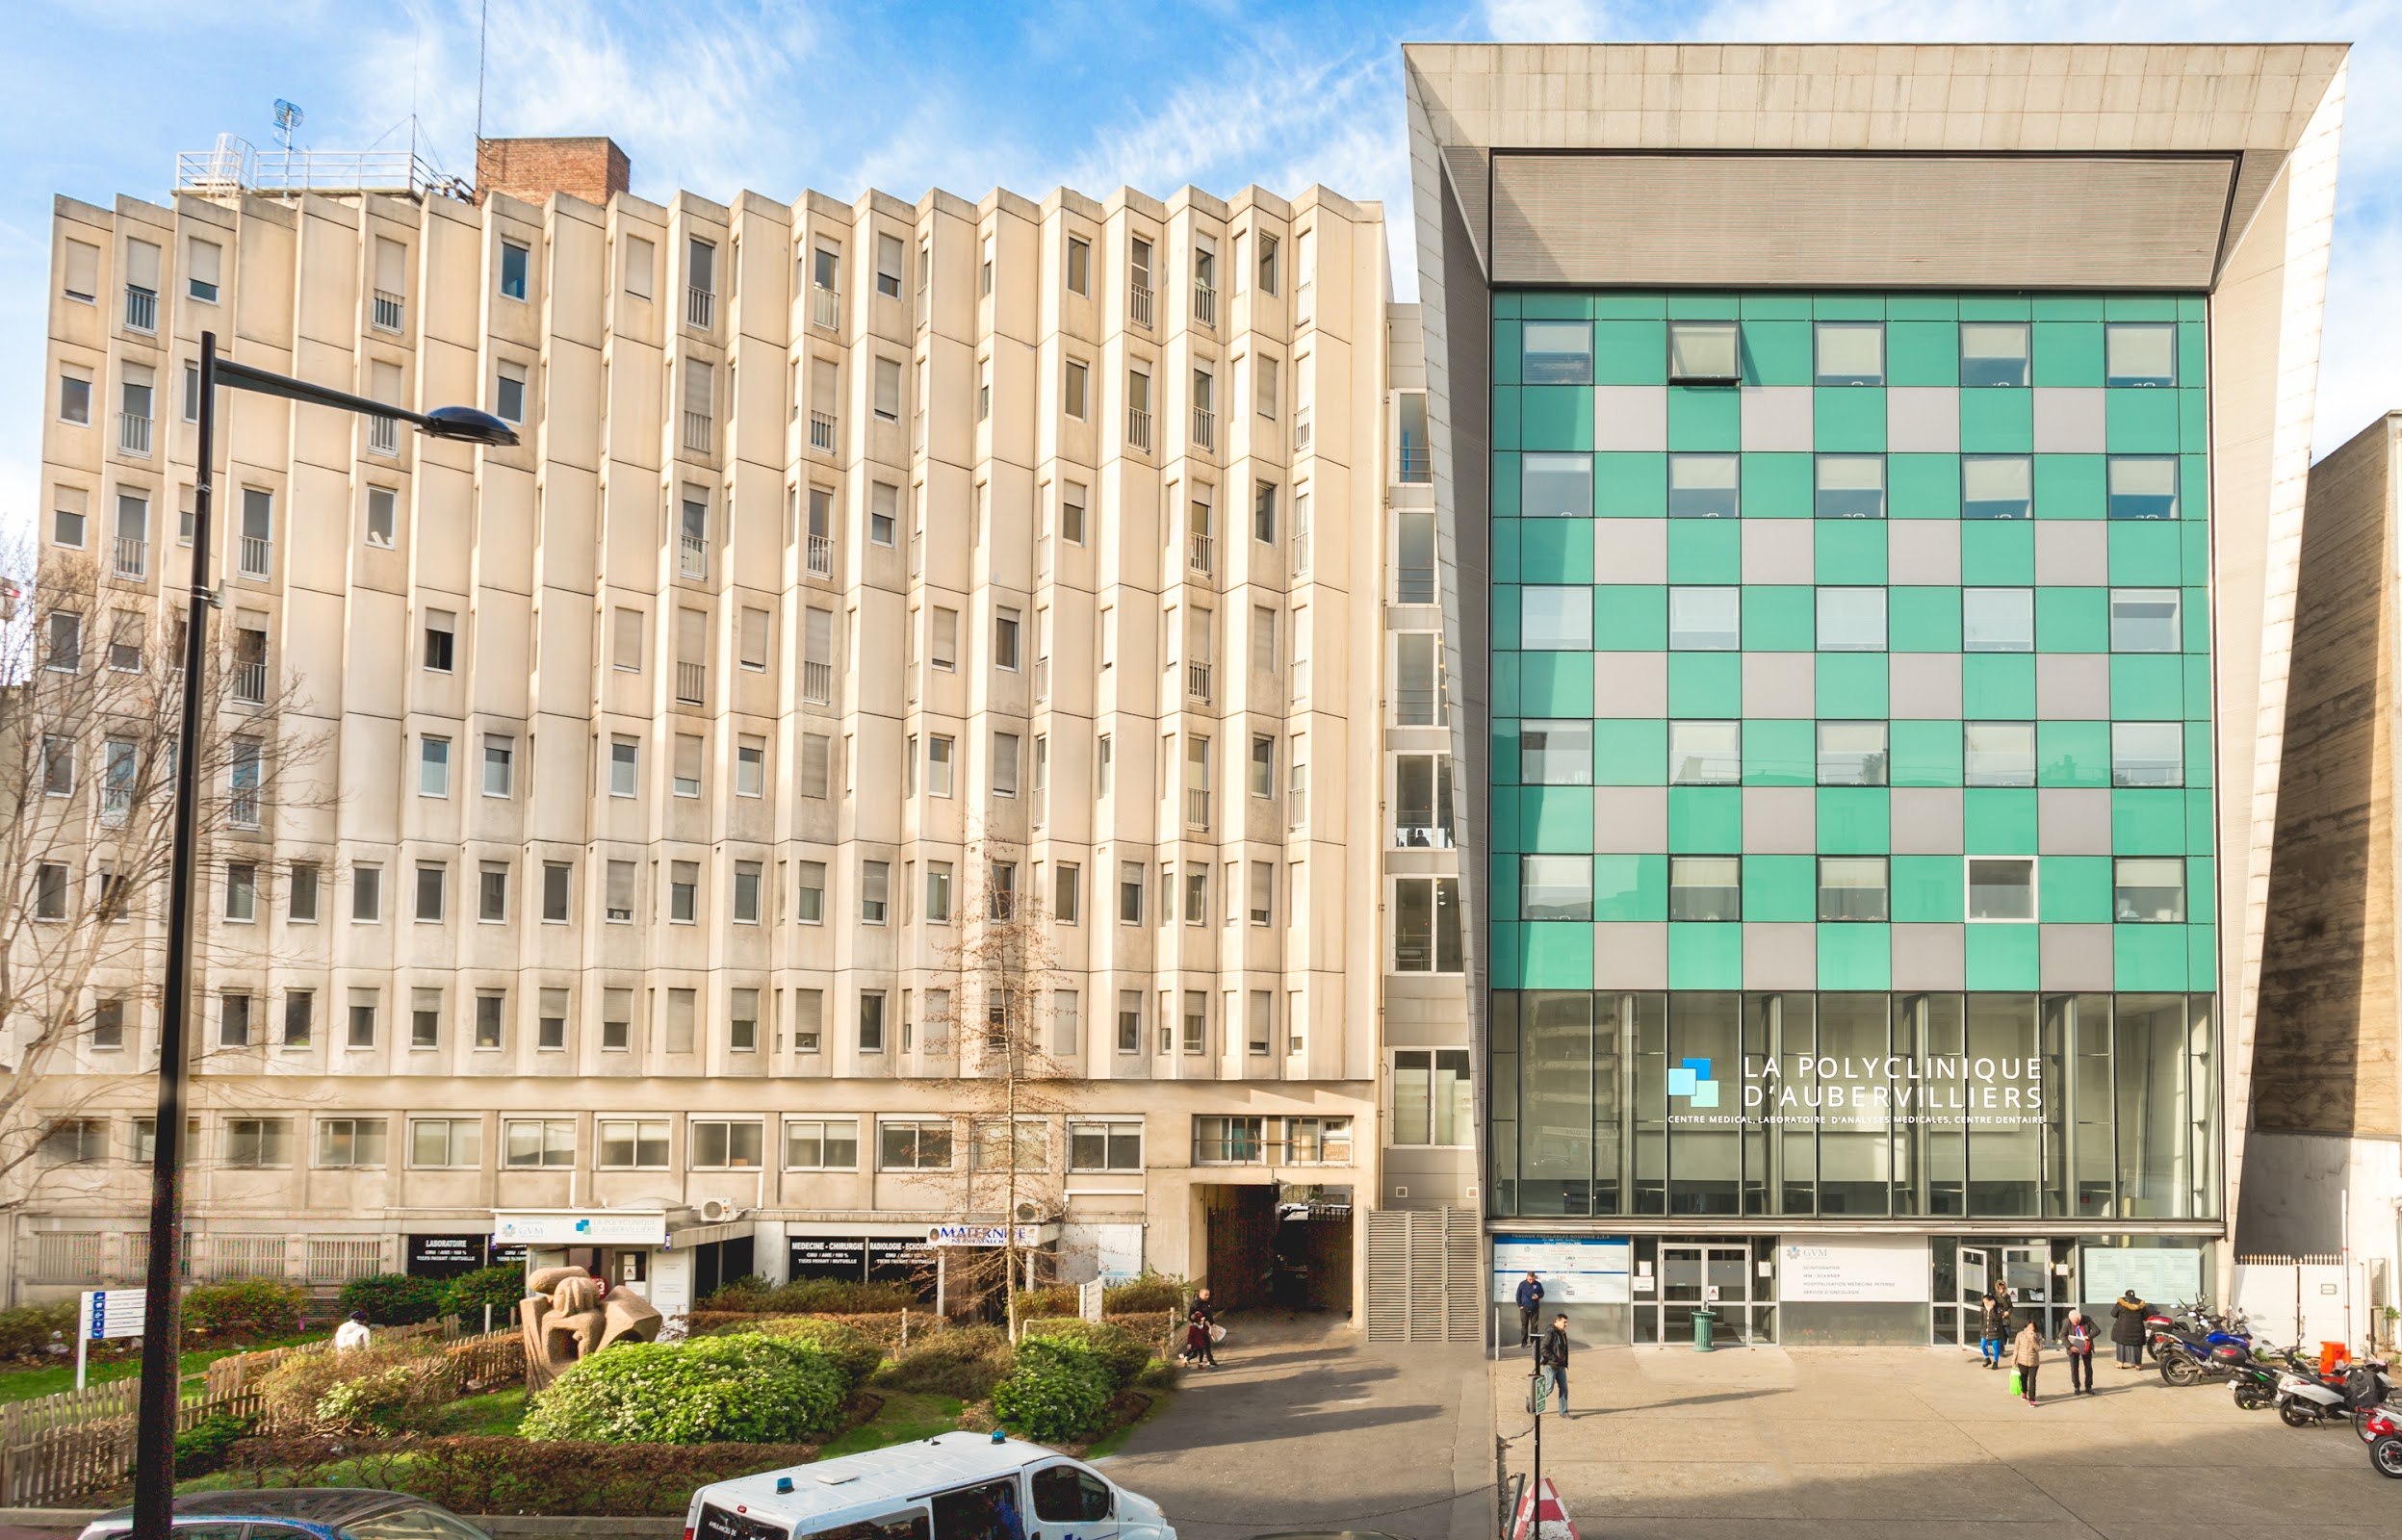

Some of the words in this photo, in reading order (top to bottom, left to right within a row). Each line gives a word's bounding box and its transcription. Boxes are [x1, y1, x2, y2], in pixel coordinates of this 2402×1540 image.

[1743, 1057, 1781, 1079] LA
[1798, 1057, 2043, 1084] POLYCLINIQUE
[1743, 1086, 2043, 1109] D'AUBERVILLIERS
[1668, 1116, 1706, 1124] CENTRE
[1709, 1116, 1757, 1125] MEDICAL,
[1758, 1116, 1826, 1124] LABORATOIRE
[1831, 1116, 1890, 1124] D'ANALYSES
[1894, 1116, 1952, 1125] MEDICALES,
[1954, 1116, 1993, 1124] CENTRE
[1996, 1116, 2045, 1124] DENTAIRE
[426, 1240, 467, 1248] LABORATOIRE
[1803, 1248, 1828, 1257] GVM
